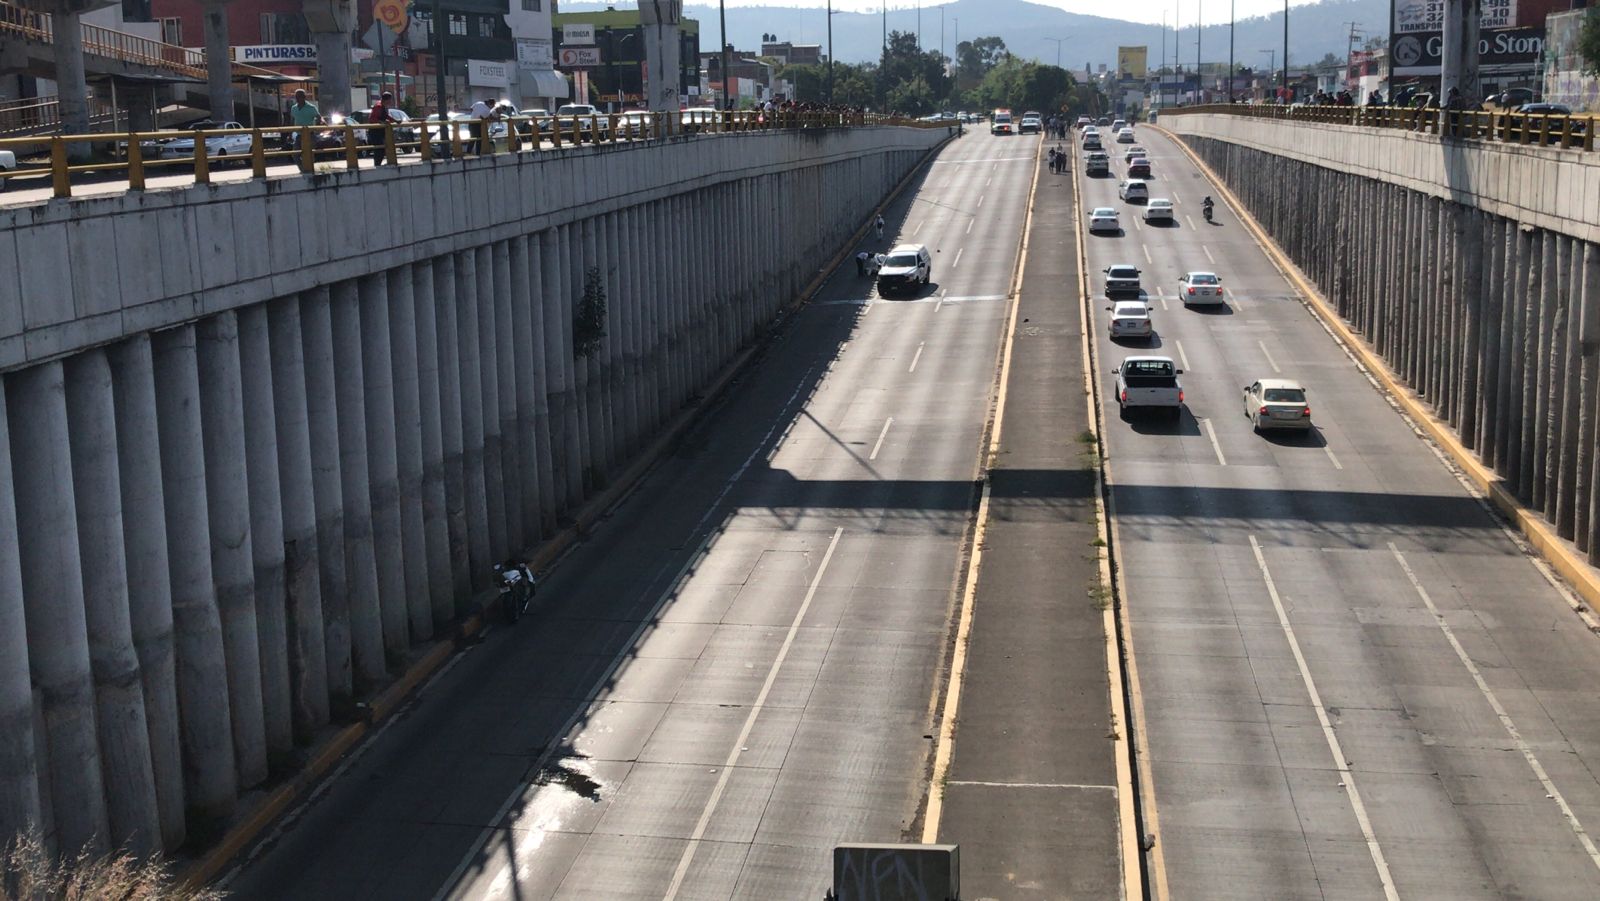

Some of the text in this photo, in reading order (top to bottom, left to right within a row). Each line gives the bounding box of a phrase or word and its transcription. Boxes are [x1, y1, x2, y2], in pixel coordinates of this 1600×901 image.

[1400, 22, 1443, 31] TRANSPOR
[245, 47, 305, 58] PINTURAS
[579, 50, 592, 58] Fox
[579, 57, 597, 65] Steel
[480, 65, 505, 77] FOXSTEEL
